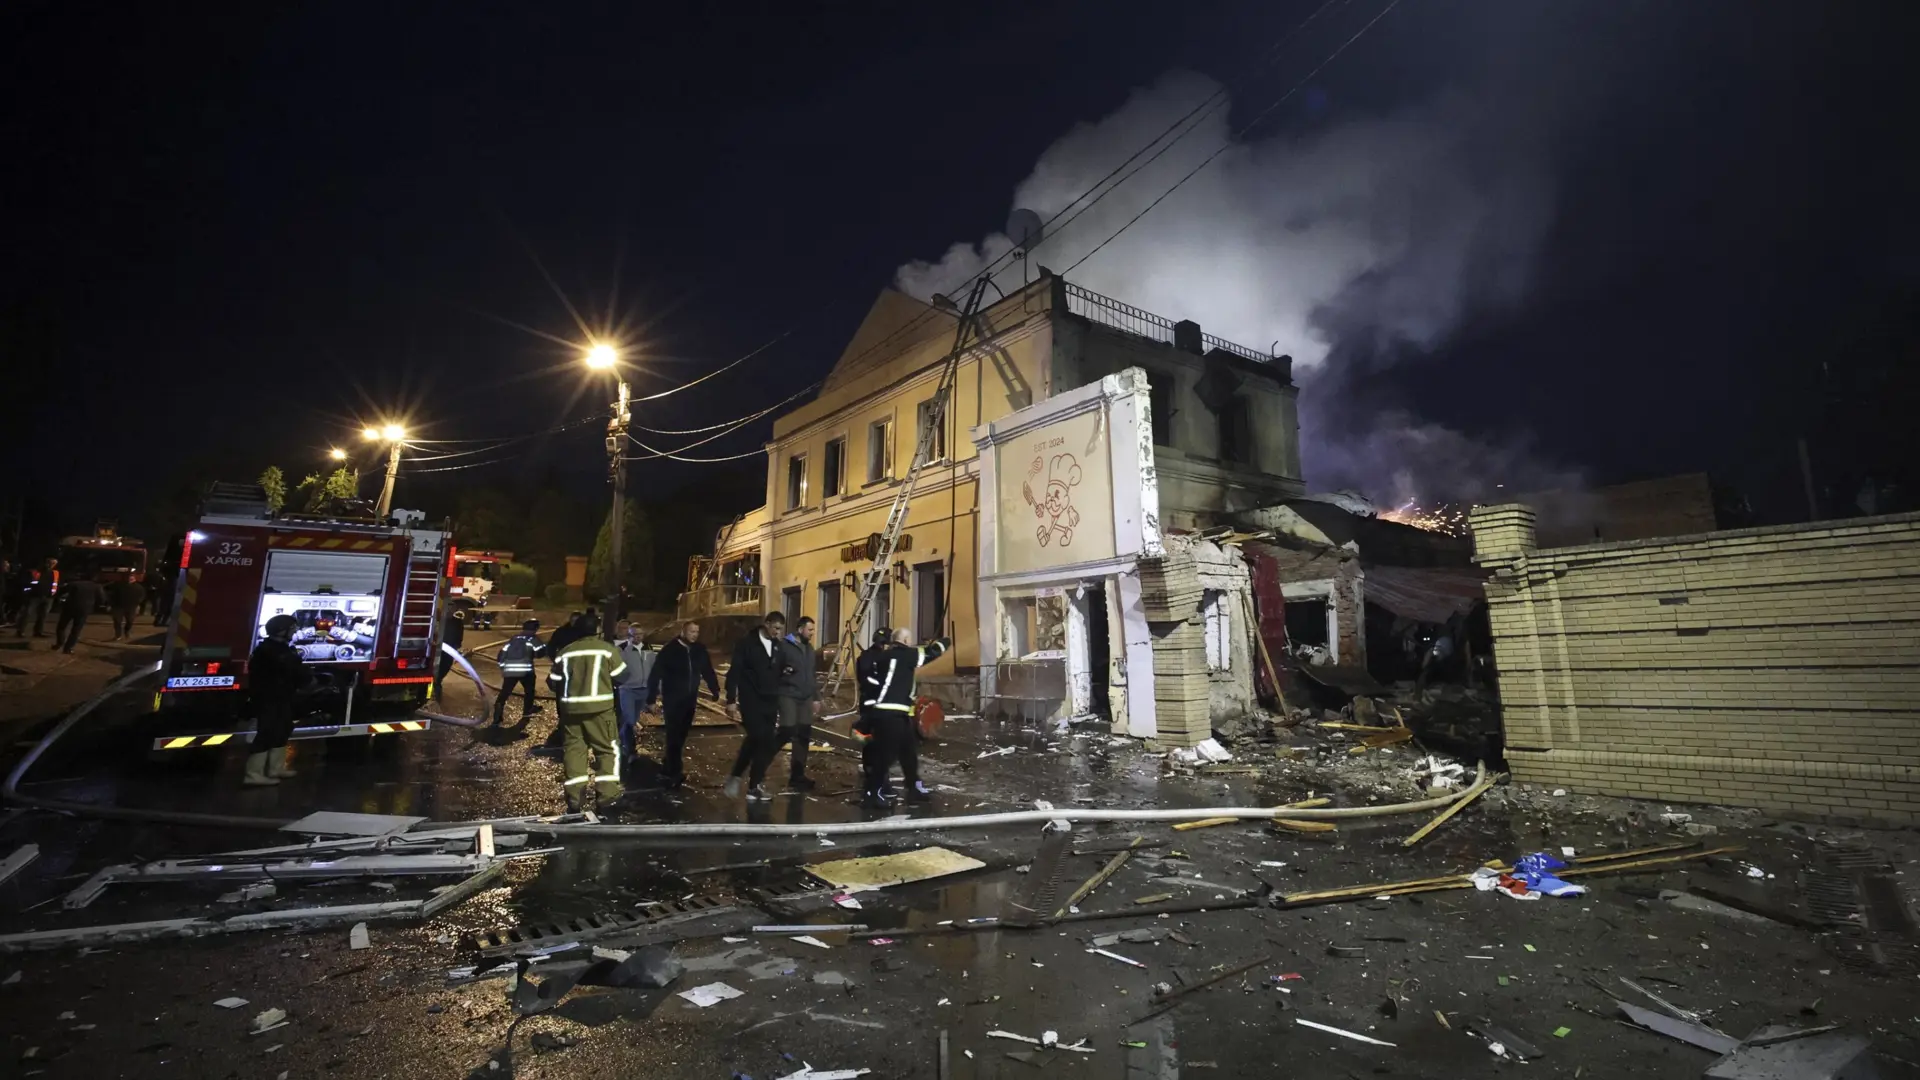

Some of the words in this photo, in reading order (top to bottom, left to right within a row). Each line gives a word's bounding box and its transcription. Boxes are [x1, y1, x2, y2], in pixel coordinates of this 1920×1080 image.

[1048, 436, 1064, 448] 2024
[220, 542, 242, 555] 32
[204, 556, 253, 566] ХАРКІВ
